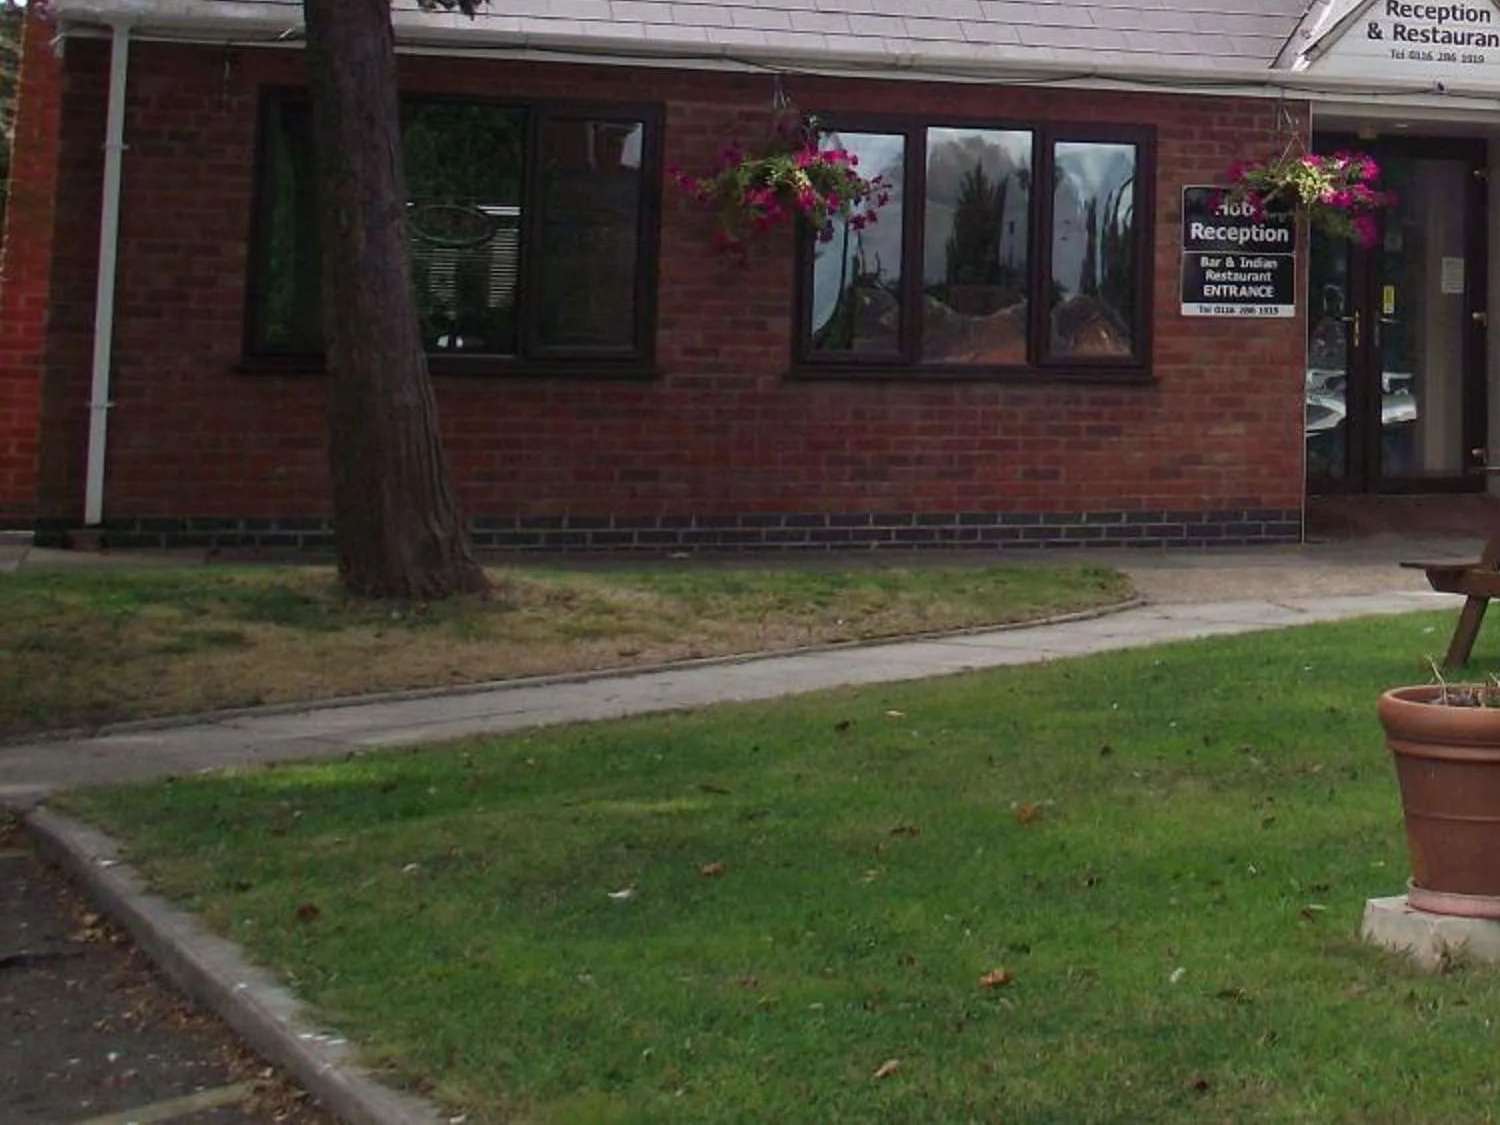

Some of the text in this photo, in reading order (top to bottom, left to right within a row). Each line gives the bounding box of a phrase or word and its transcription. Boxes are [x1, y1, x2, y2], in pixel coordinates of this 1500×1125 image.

[1386, 0, 1492, 25] Reception
[1367, 23, 1383, 40] &
[1190, 222, 1290, 245] Reception
[1200, 256, 1279, 269] Bar & Indian
[1205, 269, 1272, 282] Restaurant
[1203, 284, 1275, 298] ENTRANCE
